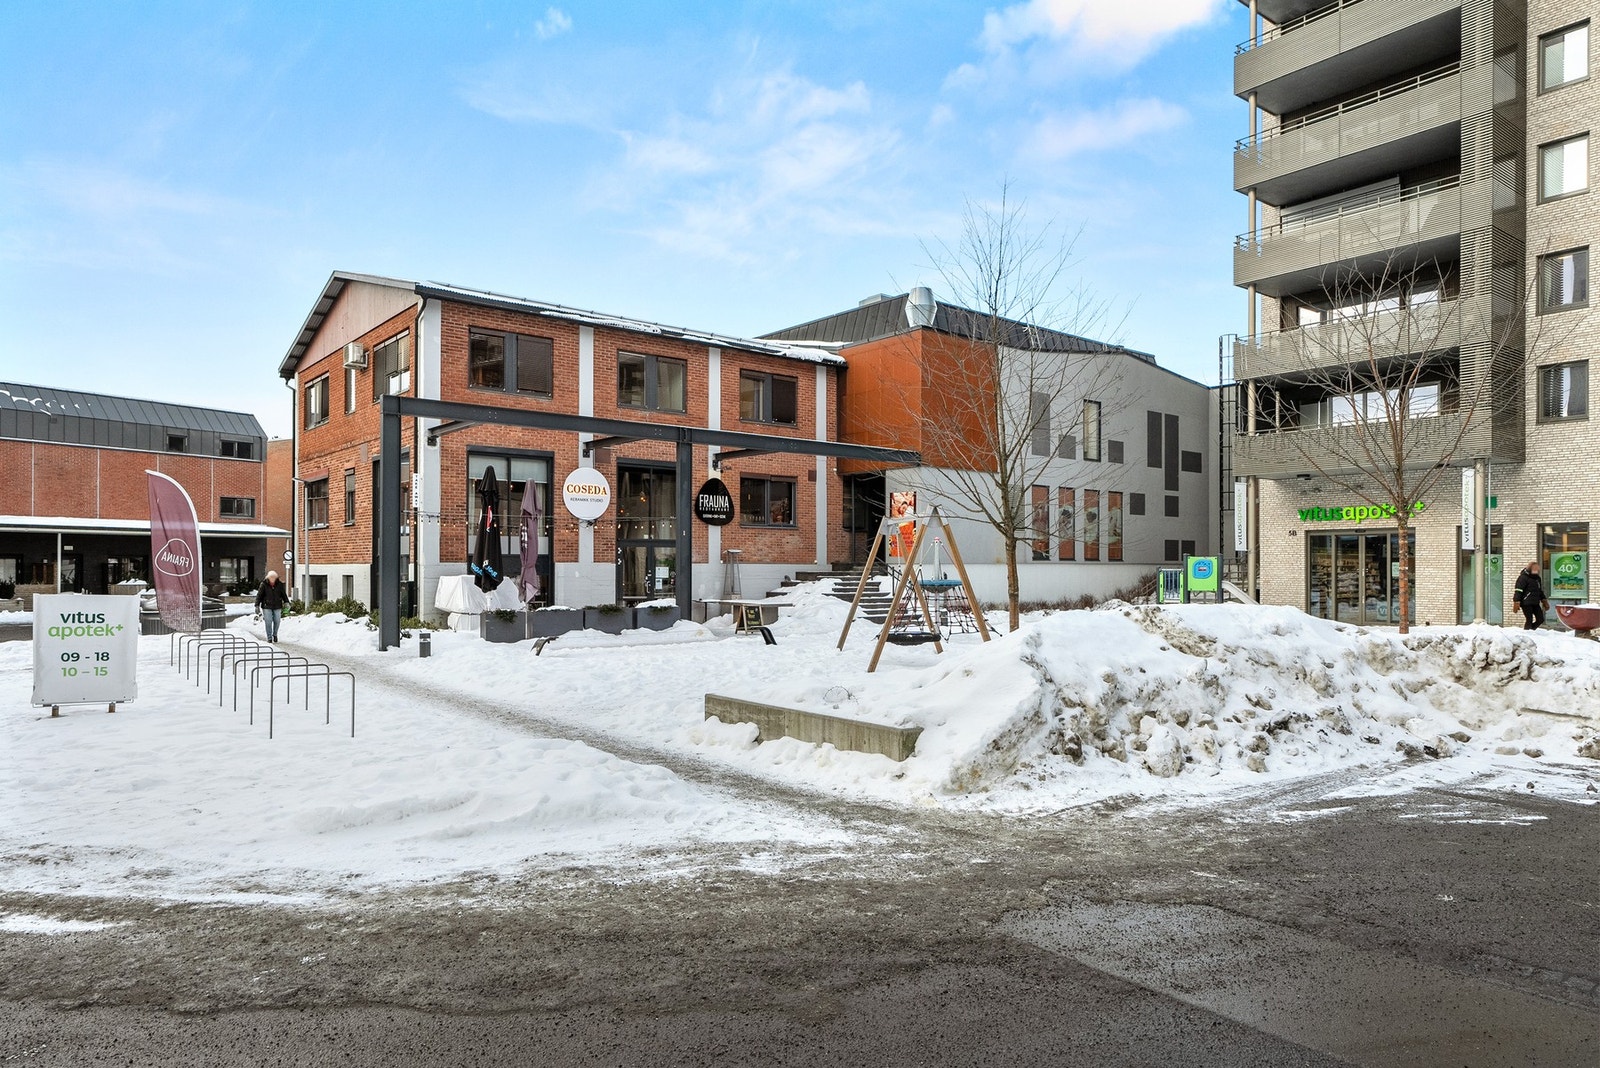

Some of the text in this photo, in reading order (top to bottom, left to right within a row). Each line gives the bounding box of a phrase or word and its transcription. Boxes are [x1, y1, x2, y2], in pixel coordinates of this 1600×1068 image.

[566, 484, 608, 495] COSEDA
[699, 494, 729, 508] FRAUNA
[60, 611, 105, 624] vitus
[60, 652, 80, 662] 09
[94, 651, 110, 661] 18
[61, 667, 78, 677] 10
[93, 667, 108, 676] 15
